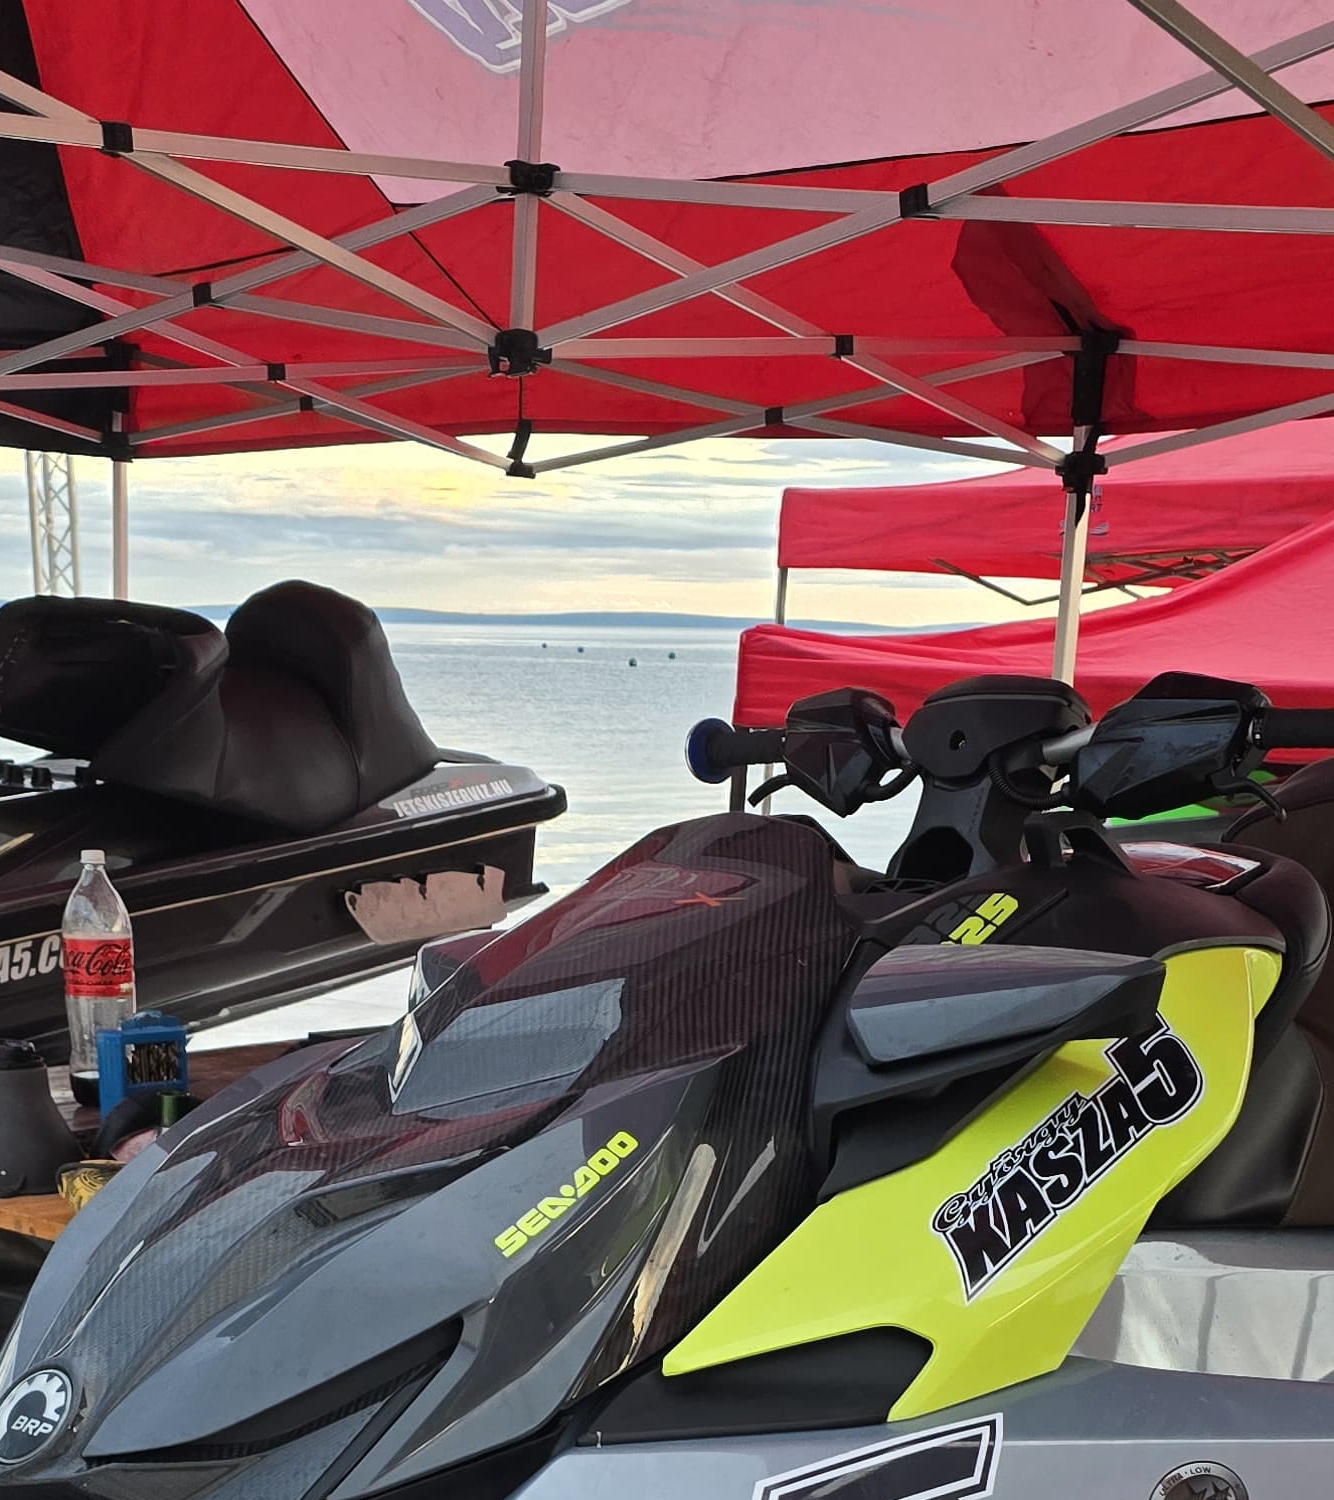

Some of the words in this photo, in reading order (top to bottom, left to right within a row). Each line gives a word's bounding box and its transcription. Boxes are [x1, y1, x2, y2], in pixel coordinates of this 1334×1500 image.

[940, 893, 1019, 945] 25
[942, 1008, 1204, 1304] KASZA5
[11, 1415, 54, 1436] BRP
